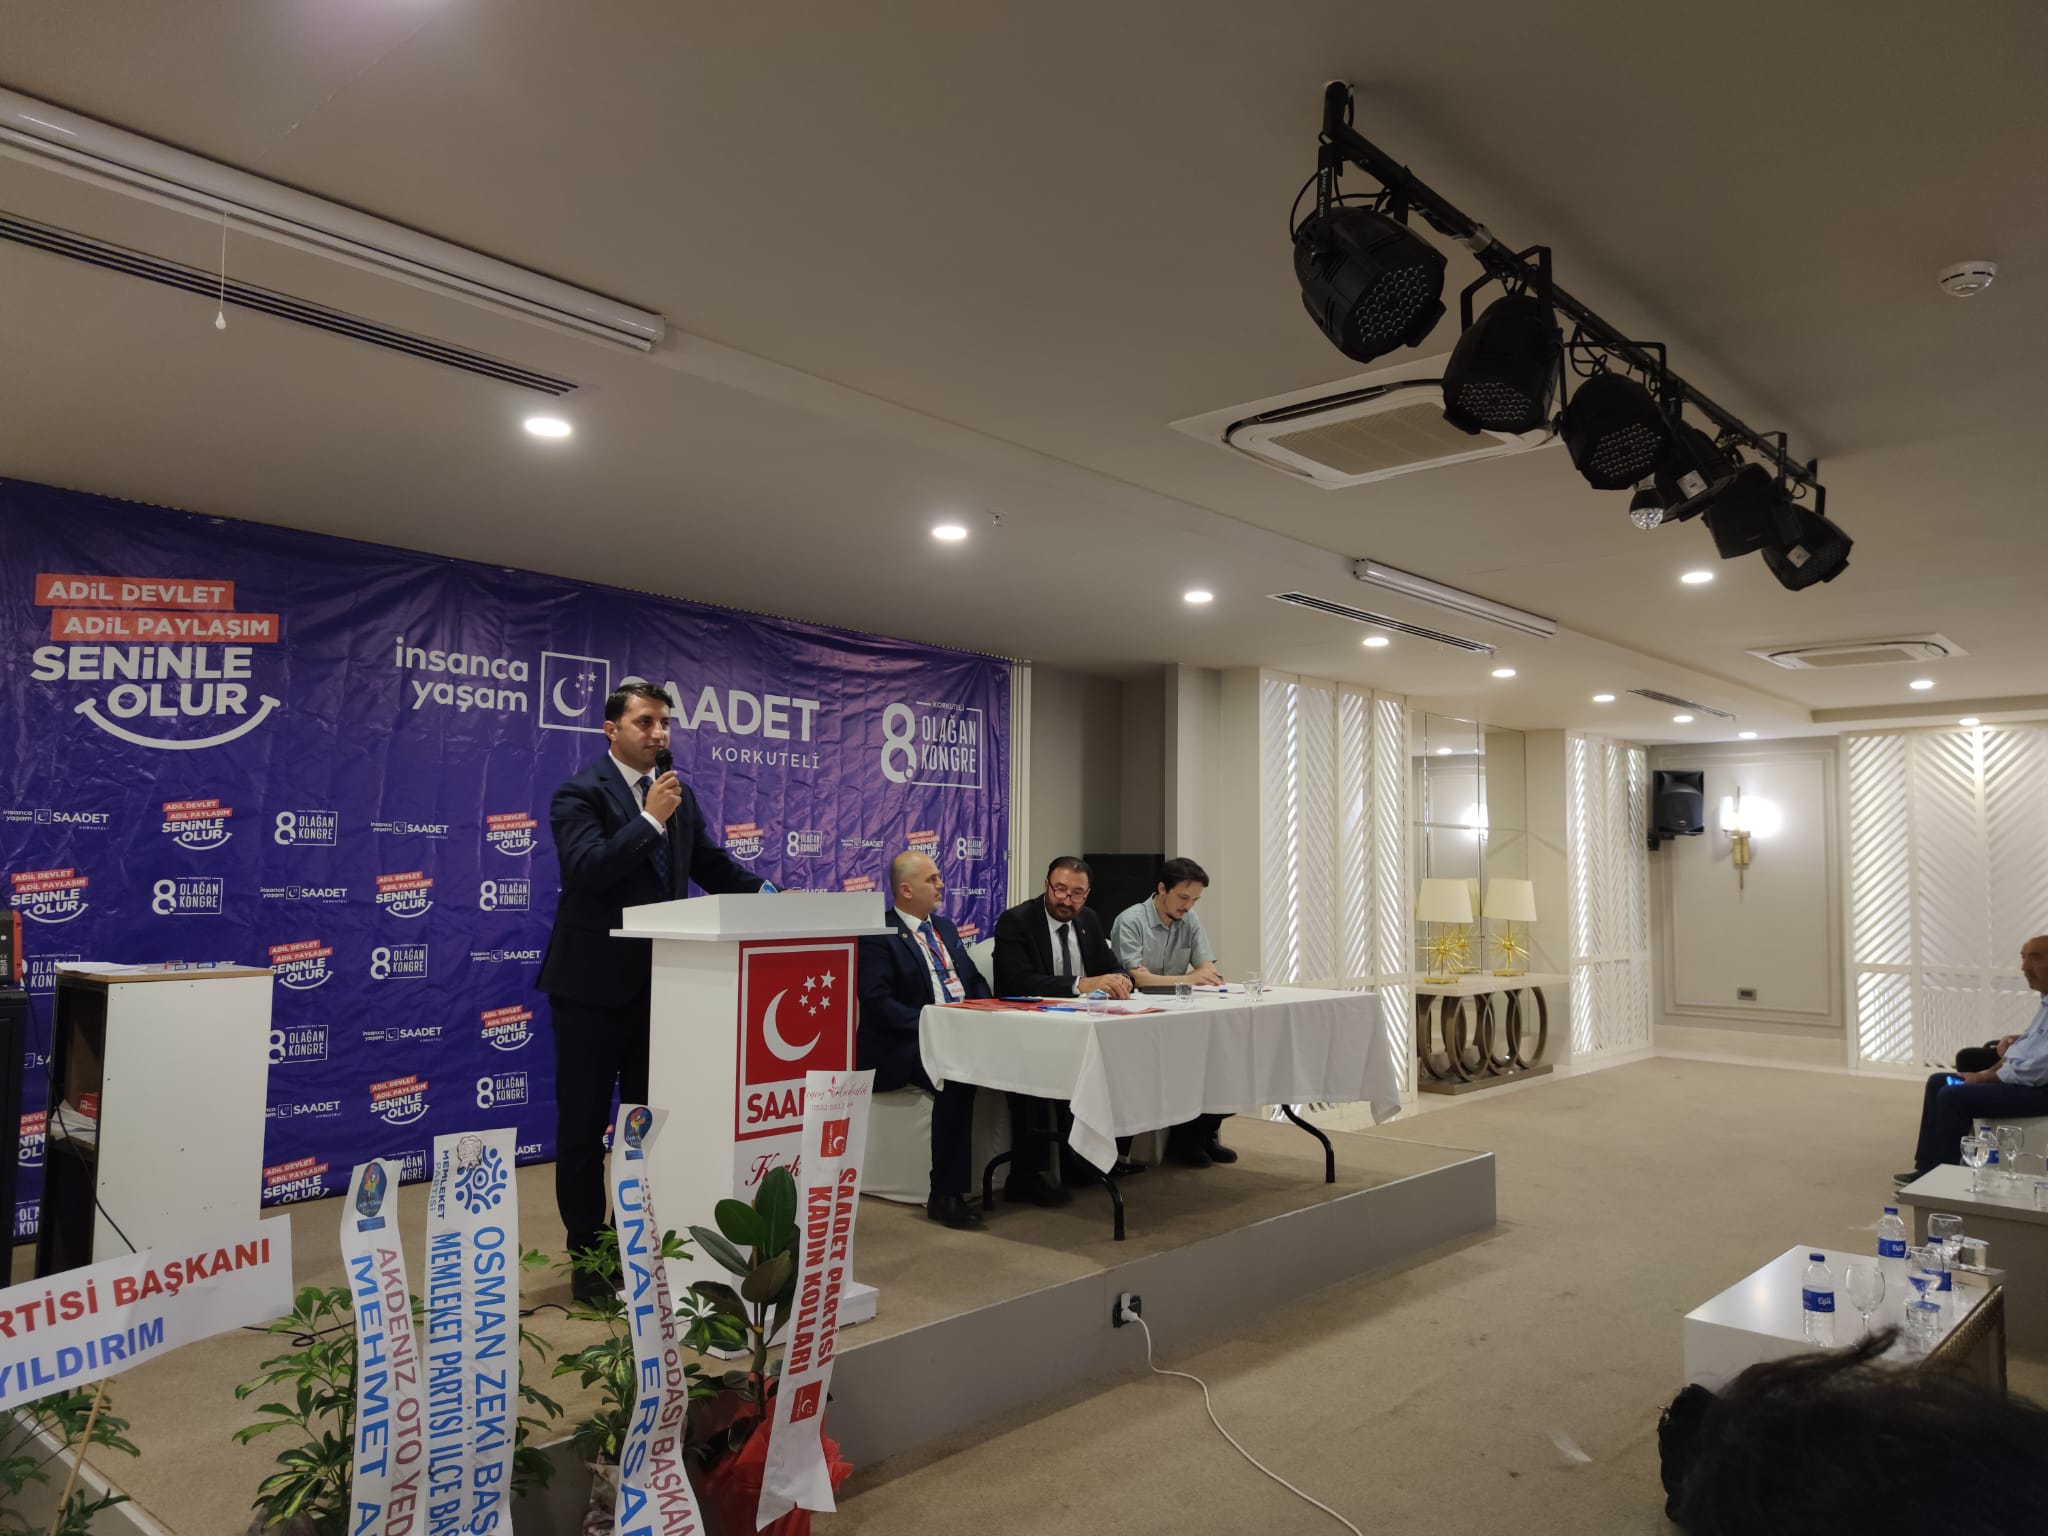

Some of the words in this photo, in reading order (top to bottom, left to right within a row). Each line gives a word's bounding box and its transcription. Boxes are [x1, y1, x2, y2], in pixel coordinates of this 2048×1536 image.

[121, 584, 225, 603] DEVLET
[395, 637, 529, 682] insanca
[108, 683, 247, 718] OLUR
[411, 679, 528, 714] yaşam
[922, 714, 976, 746] OLAĞAN
[711, 745, 820, 769] KORKUTELİ
[921, 744, 976, 773] KONGRE
[53, 812, 110, 824] SAADET
[299, 814, 334, 828] OLAĞAN
[182, 829, 223, 842] OLUR
[299, 827, 333, 840] KONGRE
[407, 824, 448, 834] SAADET
[501, 838, 530, 849] OLUR
[736, 845, 759, 855] OLUR
[180, 881, 219, 896] OLAĞAN
[301, 888, 348, 898] SAADET
[500, 882, 527, 895] OLAĞAN
[179, 896, 218, 908] KONGRE
[393, 898, 425, 911] OLUR
[499, 895, 527, 905] KONGRE
[33, 901, 78, 916] OLUR
[393, 948, 424, 961] OLAĞAN
[503, 950, 542, 960] SAADET
[392, 960, 424, 973] KONGRE
[31, 975, 56, 988] KON
[287, 969, 324, 983] OLUR
[289, 1029, 325, 1043] OLAĞAN
[400, 1027, 442, 1038] SAADET
[497, 1030, 527, 1045] OLUR
[289, 1043, 324, 1057] KONGRE
[496, 1076, 525, 1090] OLAĞAN
[496, 1089, 525, 1101] KONGRE
[293, 1101, 341, 1115] SAADET
[388, 1103, 422, 1119] OLUR
[747, 1087, 806, 1124] SAA
[515, 1144, 543, 1156] ADET
[401, 1155, 423, 1169] AĞAN
[401, 1167, 423, 1181] NGRE
[438, 1150, 449, 1220] MEMLEKET
[282, 1187, 320, 1204] OLUR
[830, 1167, 857, 1261] SAADET
[806, 1185, 833, 1268] KADIN
[617, 1177, 654, 1338] ÜNAL
[113, 1238, 270, 1308] BAŞKANI
[429, 1231, 463, 1345] MEMLEKET
[472, 1226, 507, 1360] OSMAN
[376, 1247, 419, 1391] AKDENİZ
[788, 1271, 822, 1376] KOLLARI
[0, 1316, 164, 1399] YILDIRIM
[351, 1255, 390, 1478] MEHMET
[658, 1349, 685, 1431] ODASI
[474, 1373, 512, 1453] ZEKİ
[395, 1396, 423, 1466] OTO
[620, 1357, 661, 1536] ERSA
[462, 1461, 503, 1536] BAŞ
[354, 1502, 381, 1536] A
